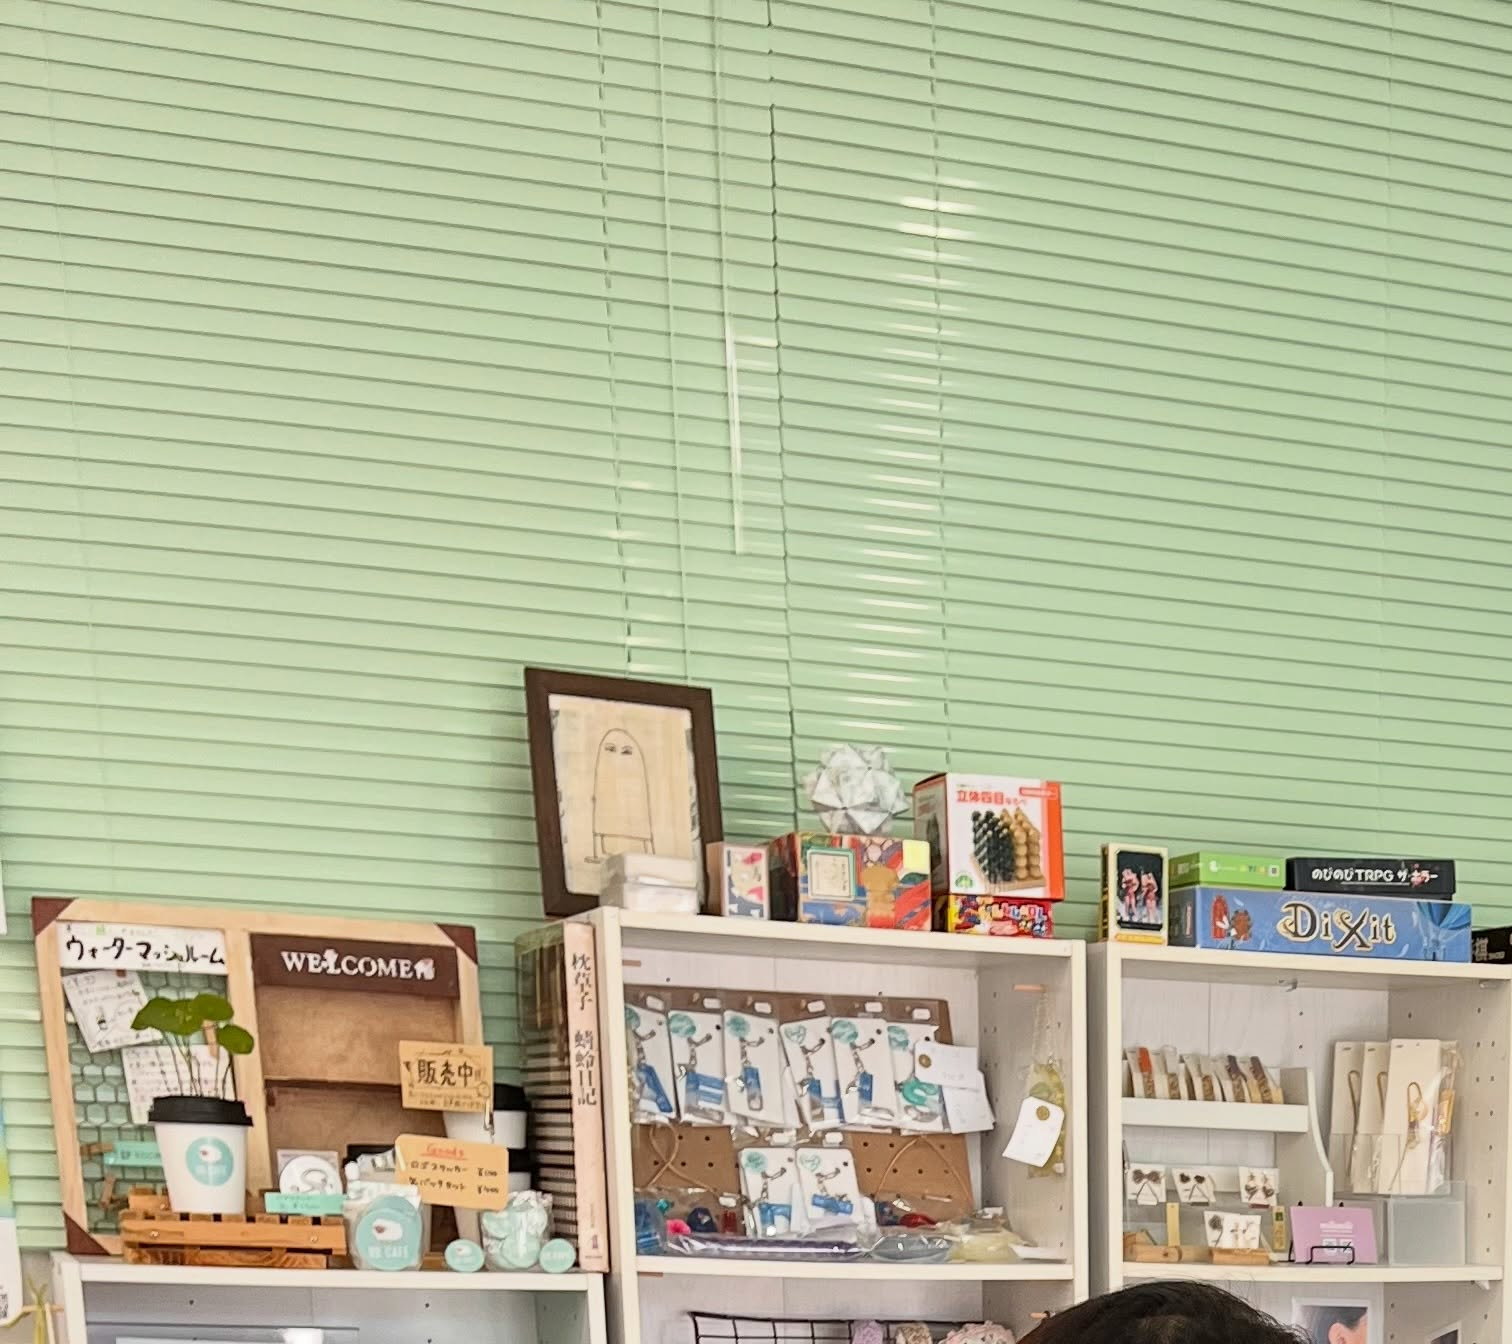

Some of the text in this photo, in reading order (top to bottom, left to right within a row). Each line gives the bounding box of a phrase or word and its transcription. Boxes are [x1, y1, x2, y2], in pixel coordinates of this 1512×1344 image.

[280, 949, 414, 979] WELCOME
[572, 953, 592, 1011] 枕草子
[416, 1059, 474, 1088] 販売中
